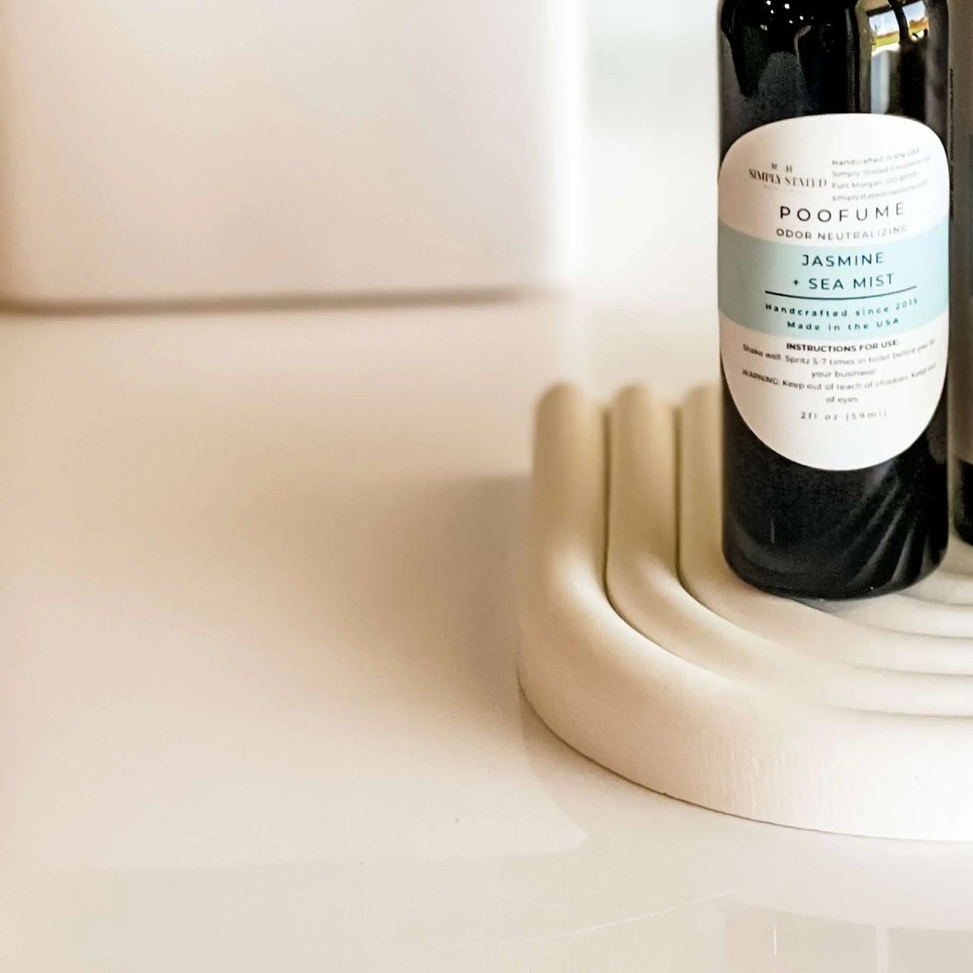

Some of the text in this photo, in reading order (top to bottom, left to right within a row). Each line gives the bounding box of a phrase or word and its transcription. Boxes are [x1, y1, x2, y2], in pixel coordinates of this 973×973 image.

[748, 168, 781, 185] SIMPLY
[785, 176, 828, 188] STATED
[779, 201, 905, 223] POOFUME
[776, 224, 908, 241] ODOR NEUTRALIZING
[801, 251, 885, 268] JASMINE
[792, 272, 896, 291] + SEA MIST
[765, 297, 919, 318] Handcrafted since 2015
[787, 316, 900, 332] Made in the USA
[786, 342, 857, 353] INSTRUCTIONS
[859, 342, 879, 352] FOR
[785, 354, 810, 365] Spritz
[811, 371, 832, 379] your
[782, 379, 805, 391] Keep
[806, 383, 822, 391] out
